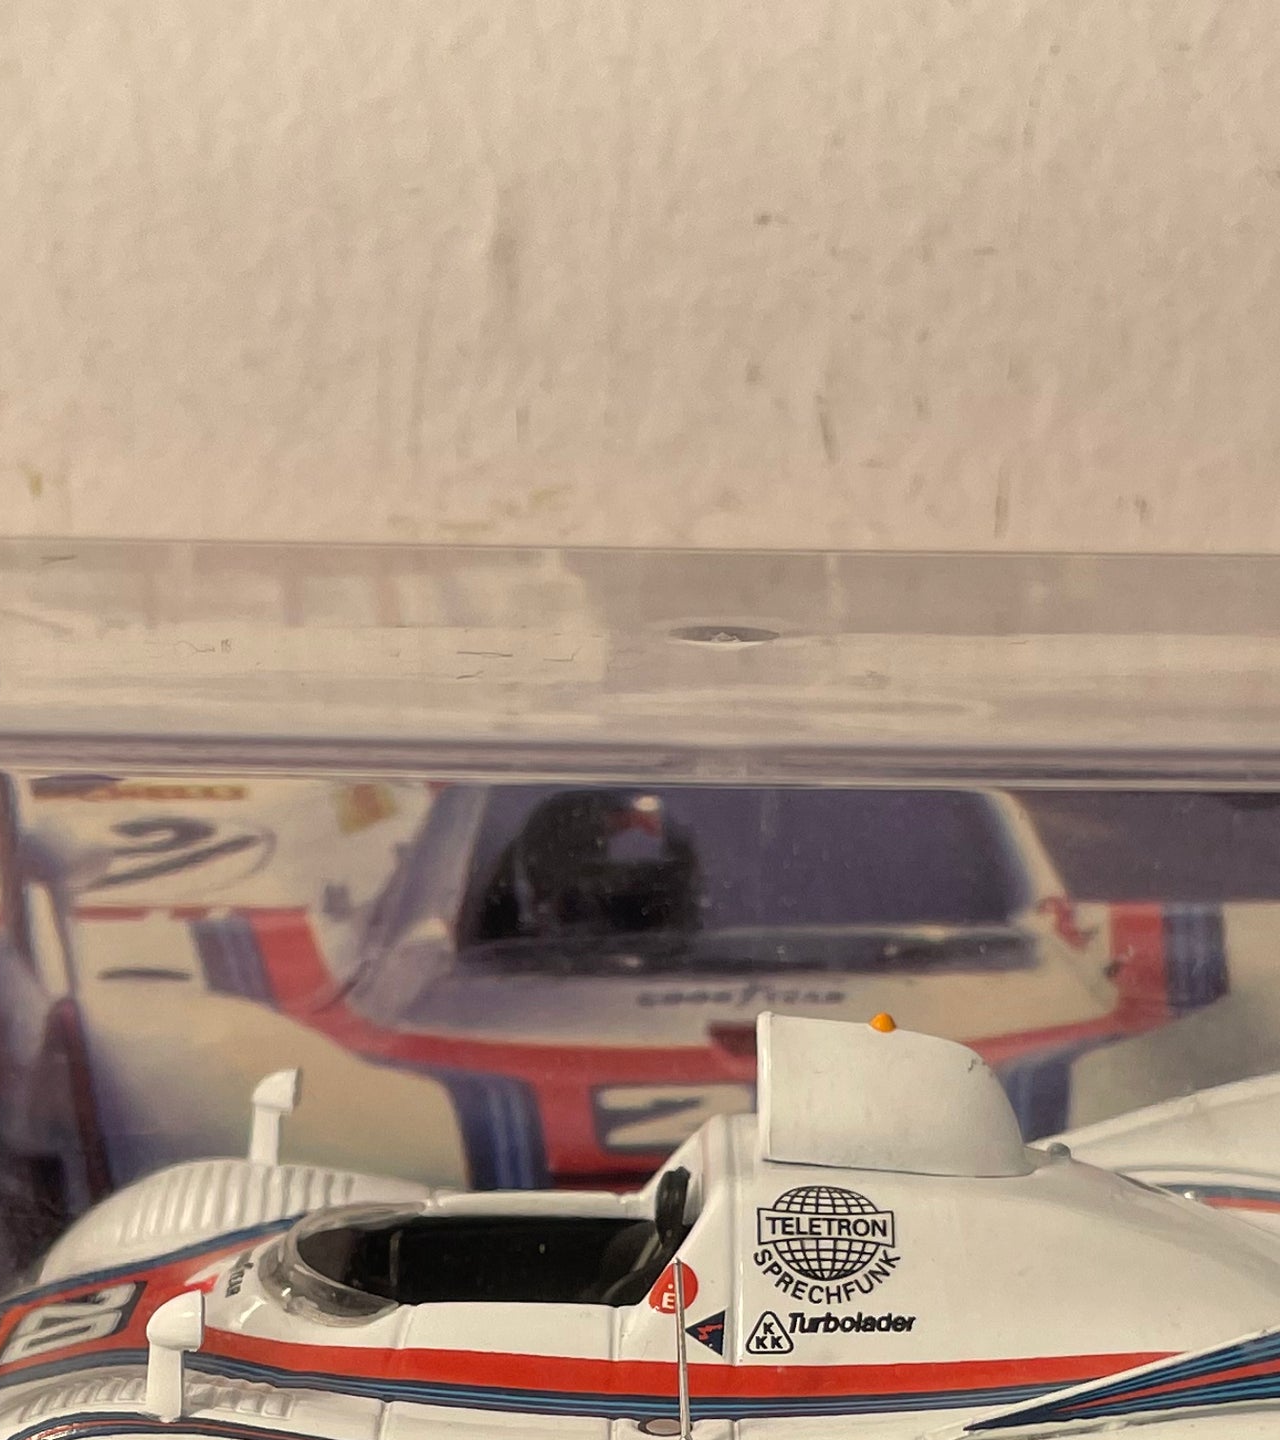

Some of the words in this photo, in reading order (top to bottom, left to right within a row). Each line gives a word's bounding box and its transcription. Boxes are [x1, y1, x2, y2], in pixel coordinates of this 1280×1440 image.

[765, 1216, 888, 1238] TELETRON
[753, 1249, 901, 1305] SPRECHFUNK
[788, 1312, 916, 1334] Turbolader
